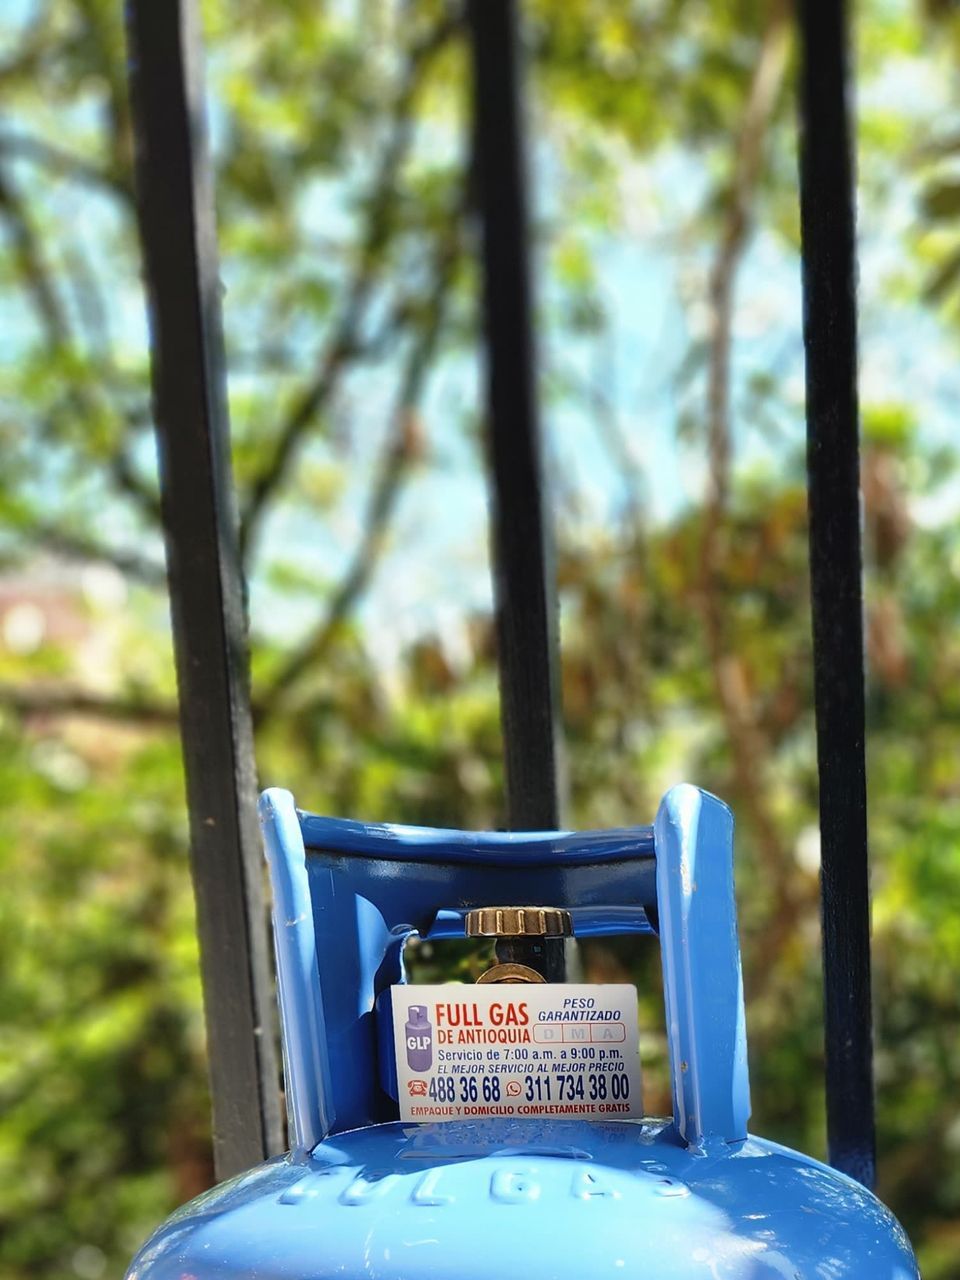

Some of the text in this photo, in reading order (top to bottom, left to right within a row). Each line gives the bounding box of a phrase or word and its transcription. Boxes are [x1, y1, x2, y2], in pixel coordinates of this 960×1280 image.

[564, 998, 595, 1009] PESO
[436, 1003, 529, 1026] FULL GAS
[538, 1011, 621, 1021] GARANTIZADO
[438, 1029, 531, 1044] DE ANTIOQUIA
[544, 1028, 613, 1039] D M A
[407, 1037, 431, 1050] GLP
[438, 1048, 623, 1061] Servicio de 7:00 a.m. a 9:00 p.m.
[438, 1062, 625, 1074] EL MEJOR SERVICIO AL MEJOR PRECIO
[429, 1076, 500, 1102] 488 36 68
[525, 1074, 629, 1101] 311 734 38 00
[411, 1103, 630, 1116] EMPAQUE Y DOMICILIO COMPLETAMENTE GRATIS
